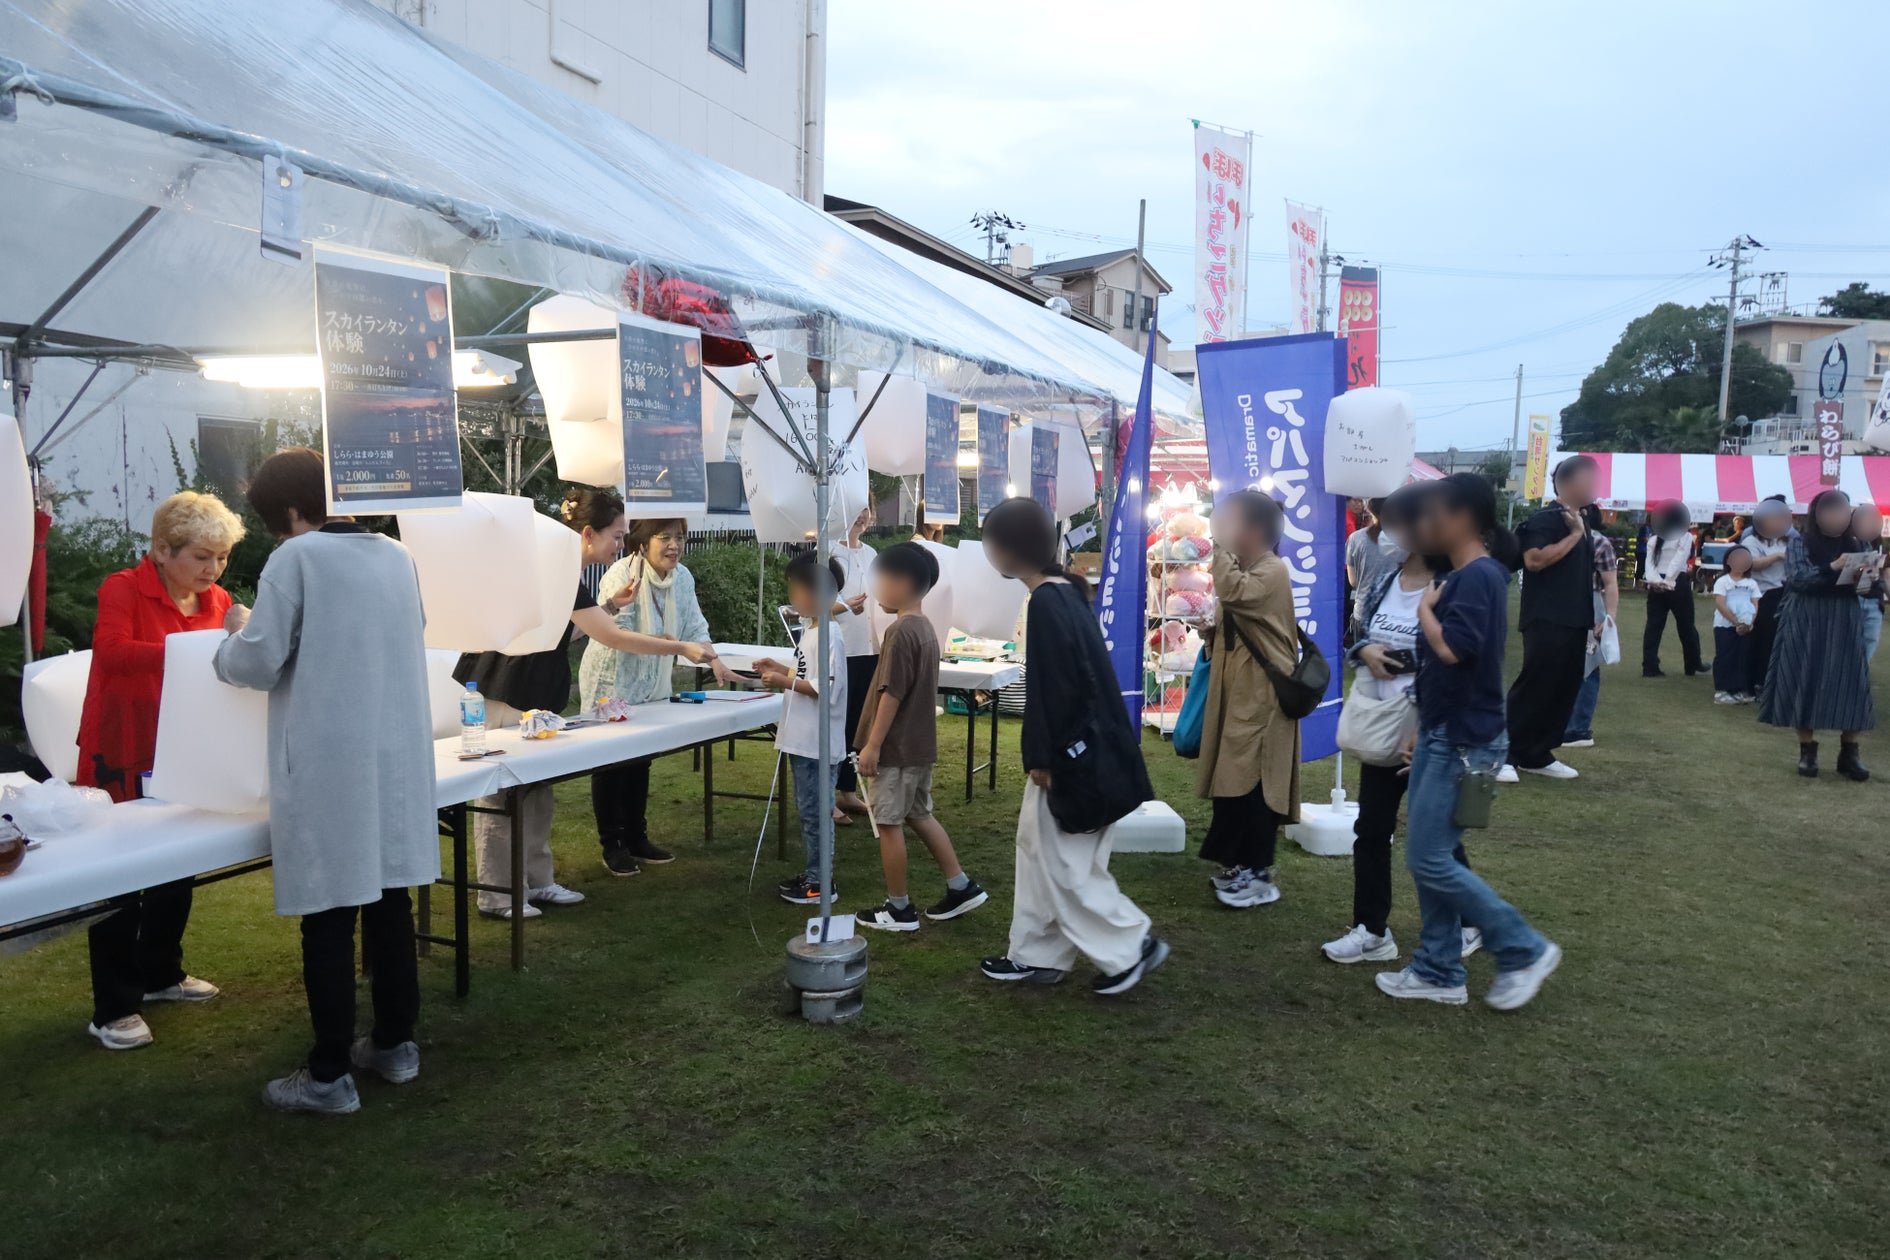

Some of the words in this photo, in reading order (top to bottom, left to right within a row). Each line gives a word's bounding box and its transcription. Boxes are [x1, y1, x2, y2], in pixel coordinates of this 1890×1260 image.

[324, 310, 408, 336] スカイランタン
[325, 329, 364, 354] 体験
[624, 359, 670, 378] スカイランタン
[624, 373, 646, 392] 体験
[1819, 409, 1840, 477] わらび餅
[1374, 613, 1418, 637] Peanut
